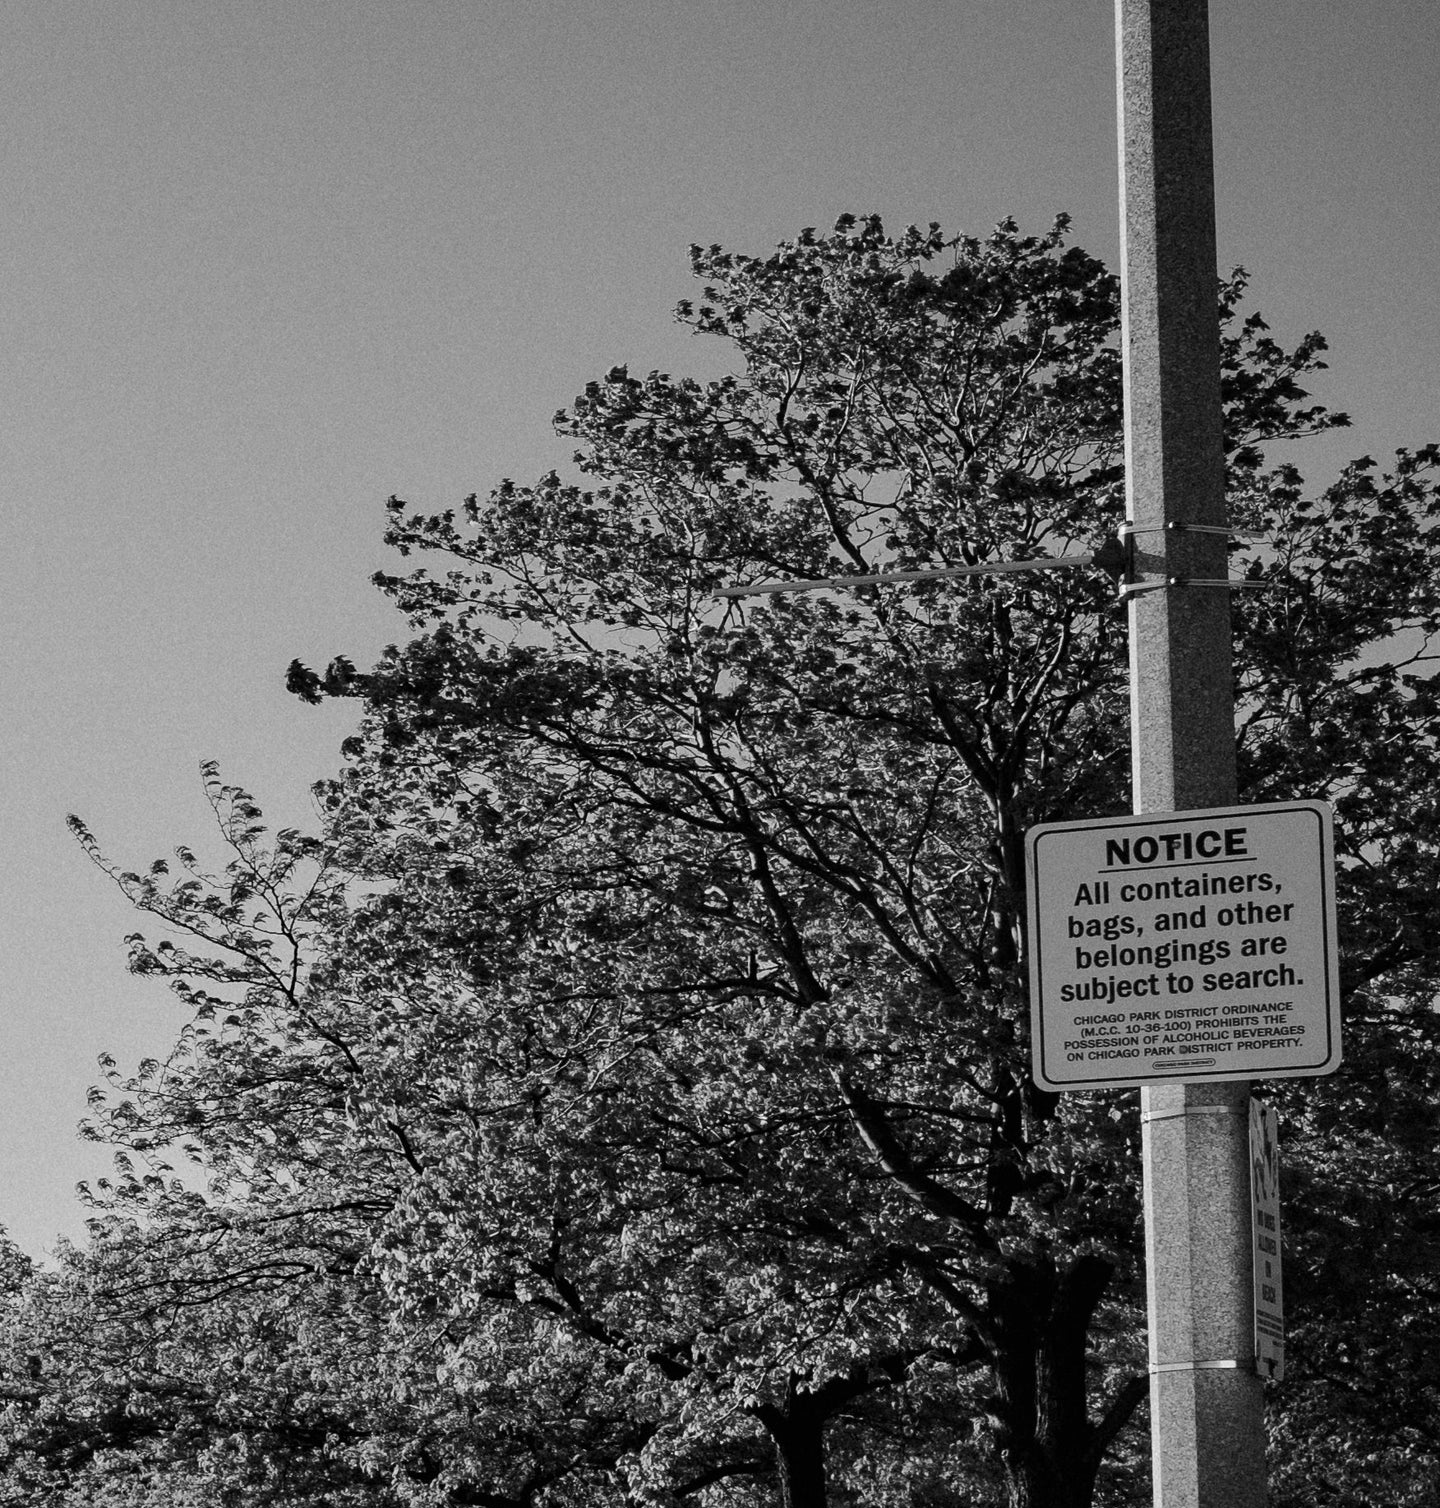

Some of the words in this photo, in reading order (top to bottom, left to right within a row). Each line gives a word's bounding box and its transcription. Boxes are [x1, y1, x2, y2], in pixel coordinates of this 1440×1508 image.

[1105, 827, 1248, 866] NOTICE
[1074, 881, 1110, 906] All
[1120, 872, 1282, 902] containers,
[1068, 915, 1144, 941] bags,
[1154, 905, 1207, 931] and
[1217, 901, 1294, 926] other
[1075, 939, 1231, 969] belongings
[1240, 935, 1287, 957] are
[1060, 974, 1160, 1004] subject
[1166, 972, 1194, 994] to
[1202, 963, 1304, 992] search.
[1073, 1013, 1126, 1026] CHICAGO
[1129, 1011, 1161, 1022] PARK
[1165, 1006, 1219, 1019] DISTRICT
[1222, 1001, 1294, 1015] ORDINANCE
[1080, 1025, 1121, 1039] (M.C.C.
[1125, 1020, 1192, 1034] 10-36-100)
[1195, 1016, 1260, 1029] PROHIBITS
[1262, 1014, 1287, 1024] THE
[1064, 1036, 1140, 1051] POSSESSION
[1143, 1035, 1159, 1045] OF
[1162, 1030, 1230, 1043] ALCOHOLIC
[1233, 1025, 1306, 1039] BEVERAGES
[1066, 1052, 1085, 1062] ON
[1088, 1048, 1141, 1060] CHICAGO
[1144, 1045, 1176, 1057] PARK
[1179, 1042, 1233, 1055] DISTRICT
[1237, 1037, 1304, 1051] PROPERTY.
